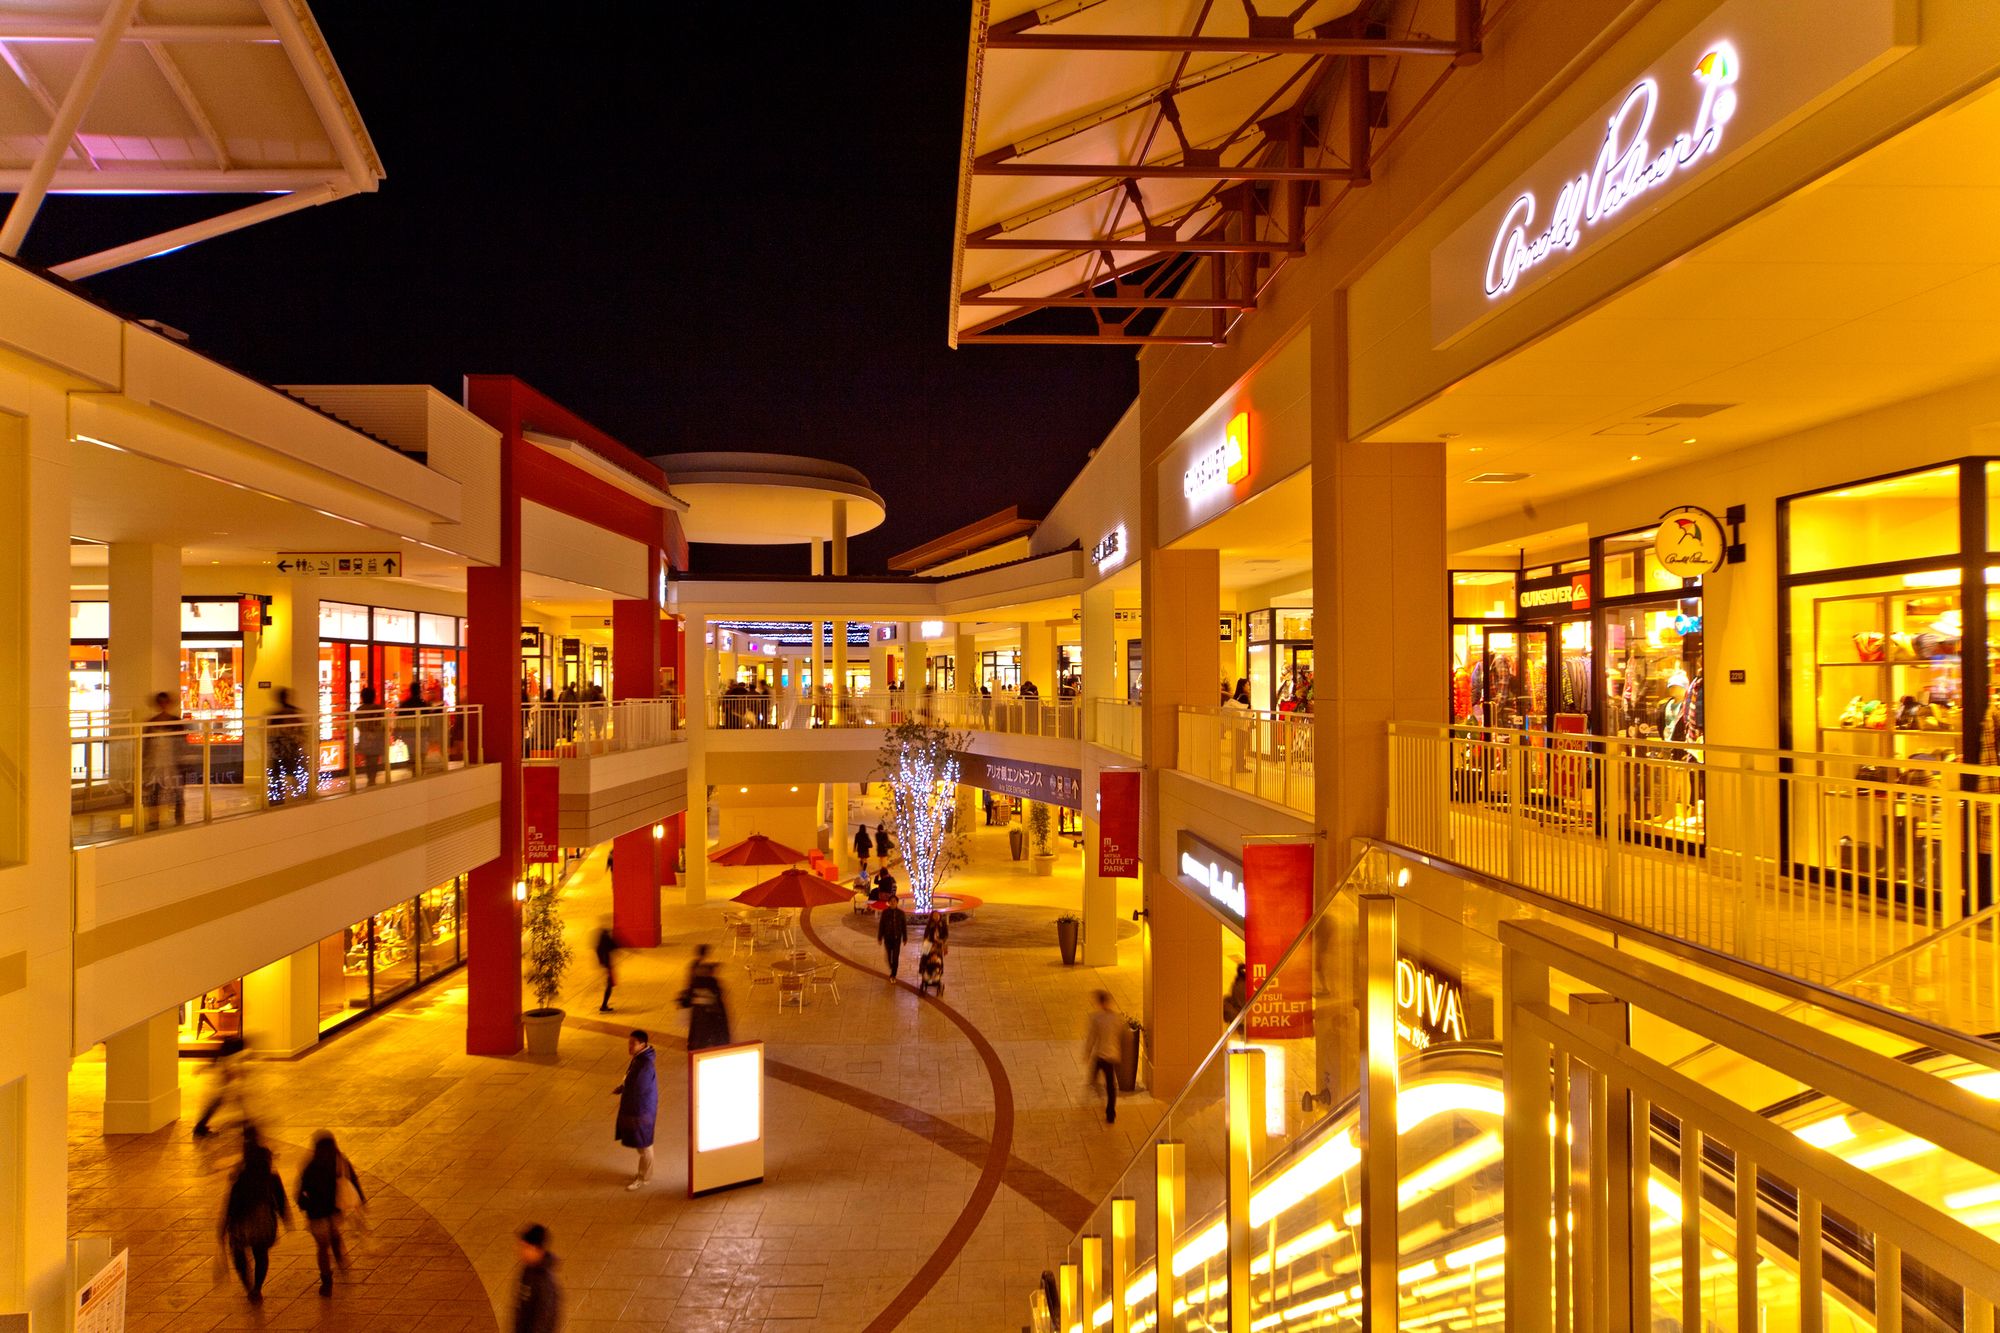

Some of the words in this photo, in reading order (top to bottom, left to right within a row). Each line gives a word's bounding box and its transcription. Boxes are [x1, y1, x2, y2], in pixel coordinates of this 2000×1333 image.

[1520, 586, 1572, 608] QUIKSILVER
[986, 763, 1043, 788] アリオ側エントランス
[1252, 1001, 1307, 1014] OUTLET
[1251, 1015, 1291, 1027] PARK
